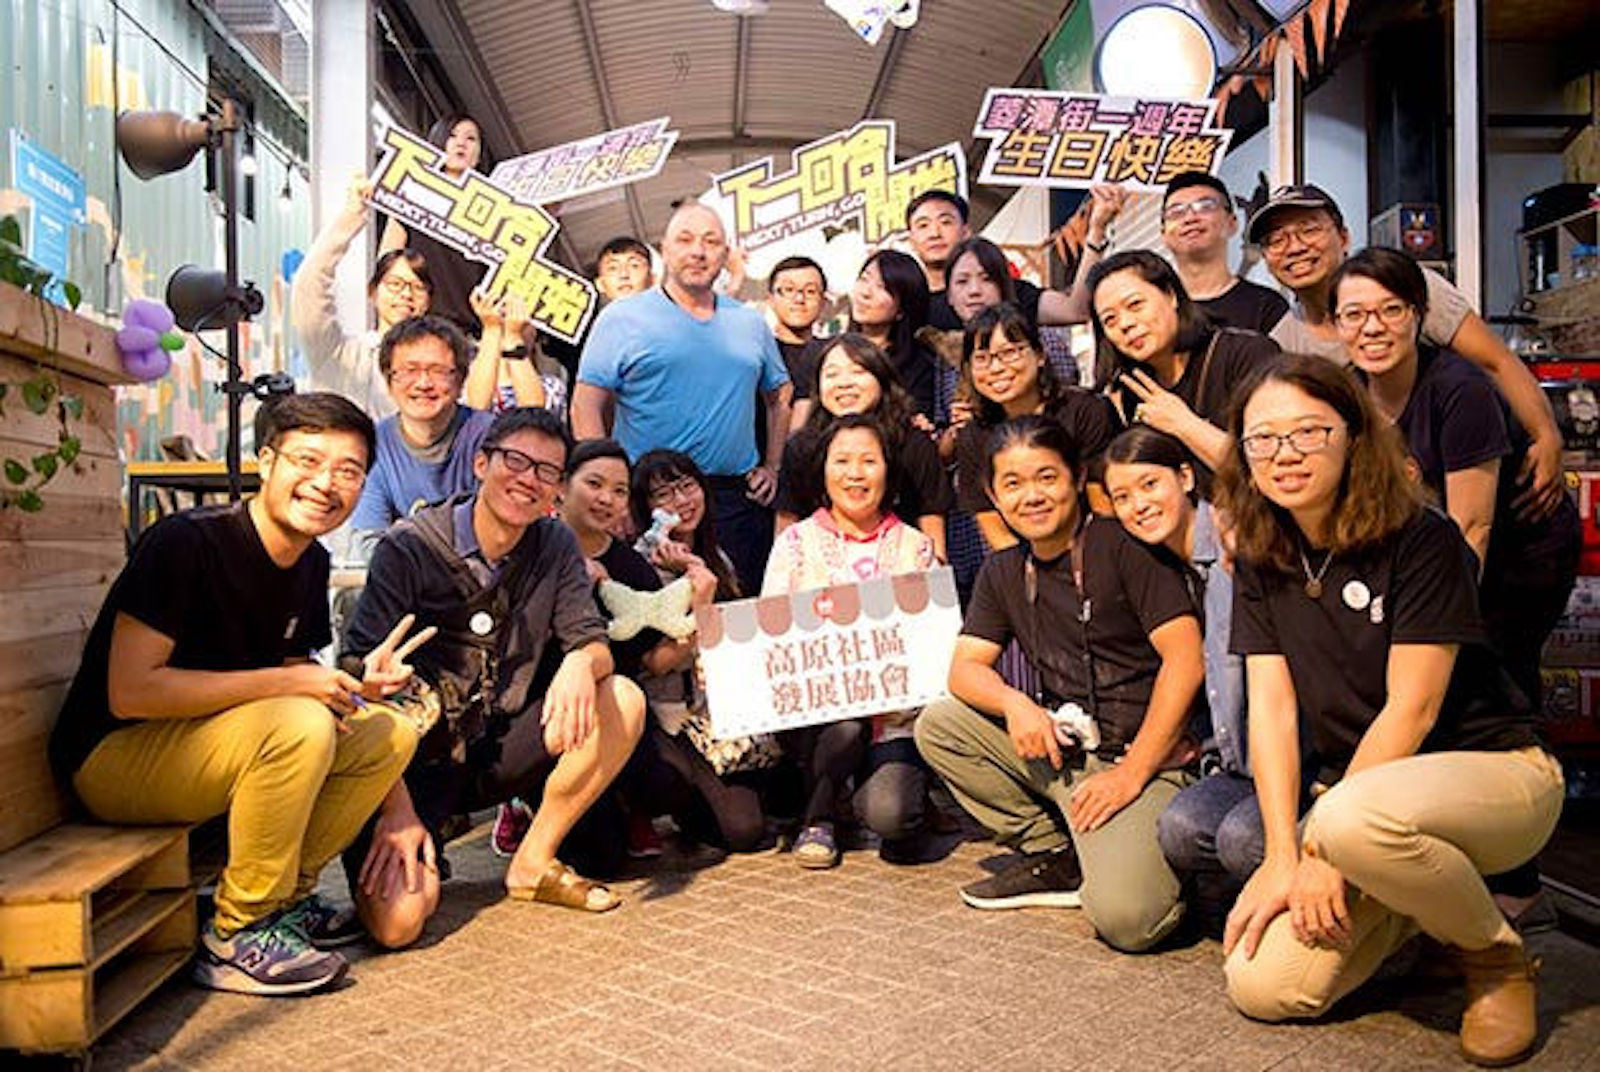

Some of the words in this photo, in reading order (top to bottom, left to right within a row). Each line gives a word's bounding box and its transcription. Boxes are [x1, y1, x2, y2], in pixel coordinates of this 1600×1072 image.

[994, 129, 1212, 183] 生日快樂
[765, 622, 905, 679] 高原社區
[772, 663, 908, 715] 發展協會
